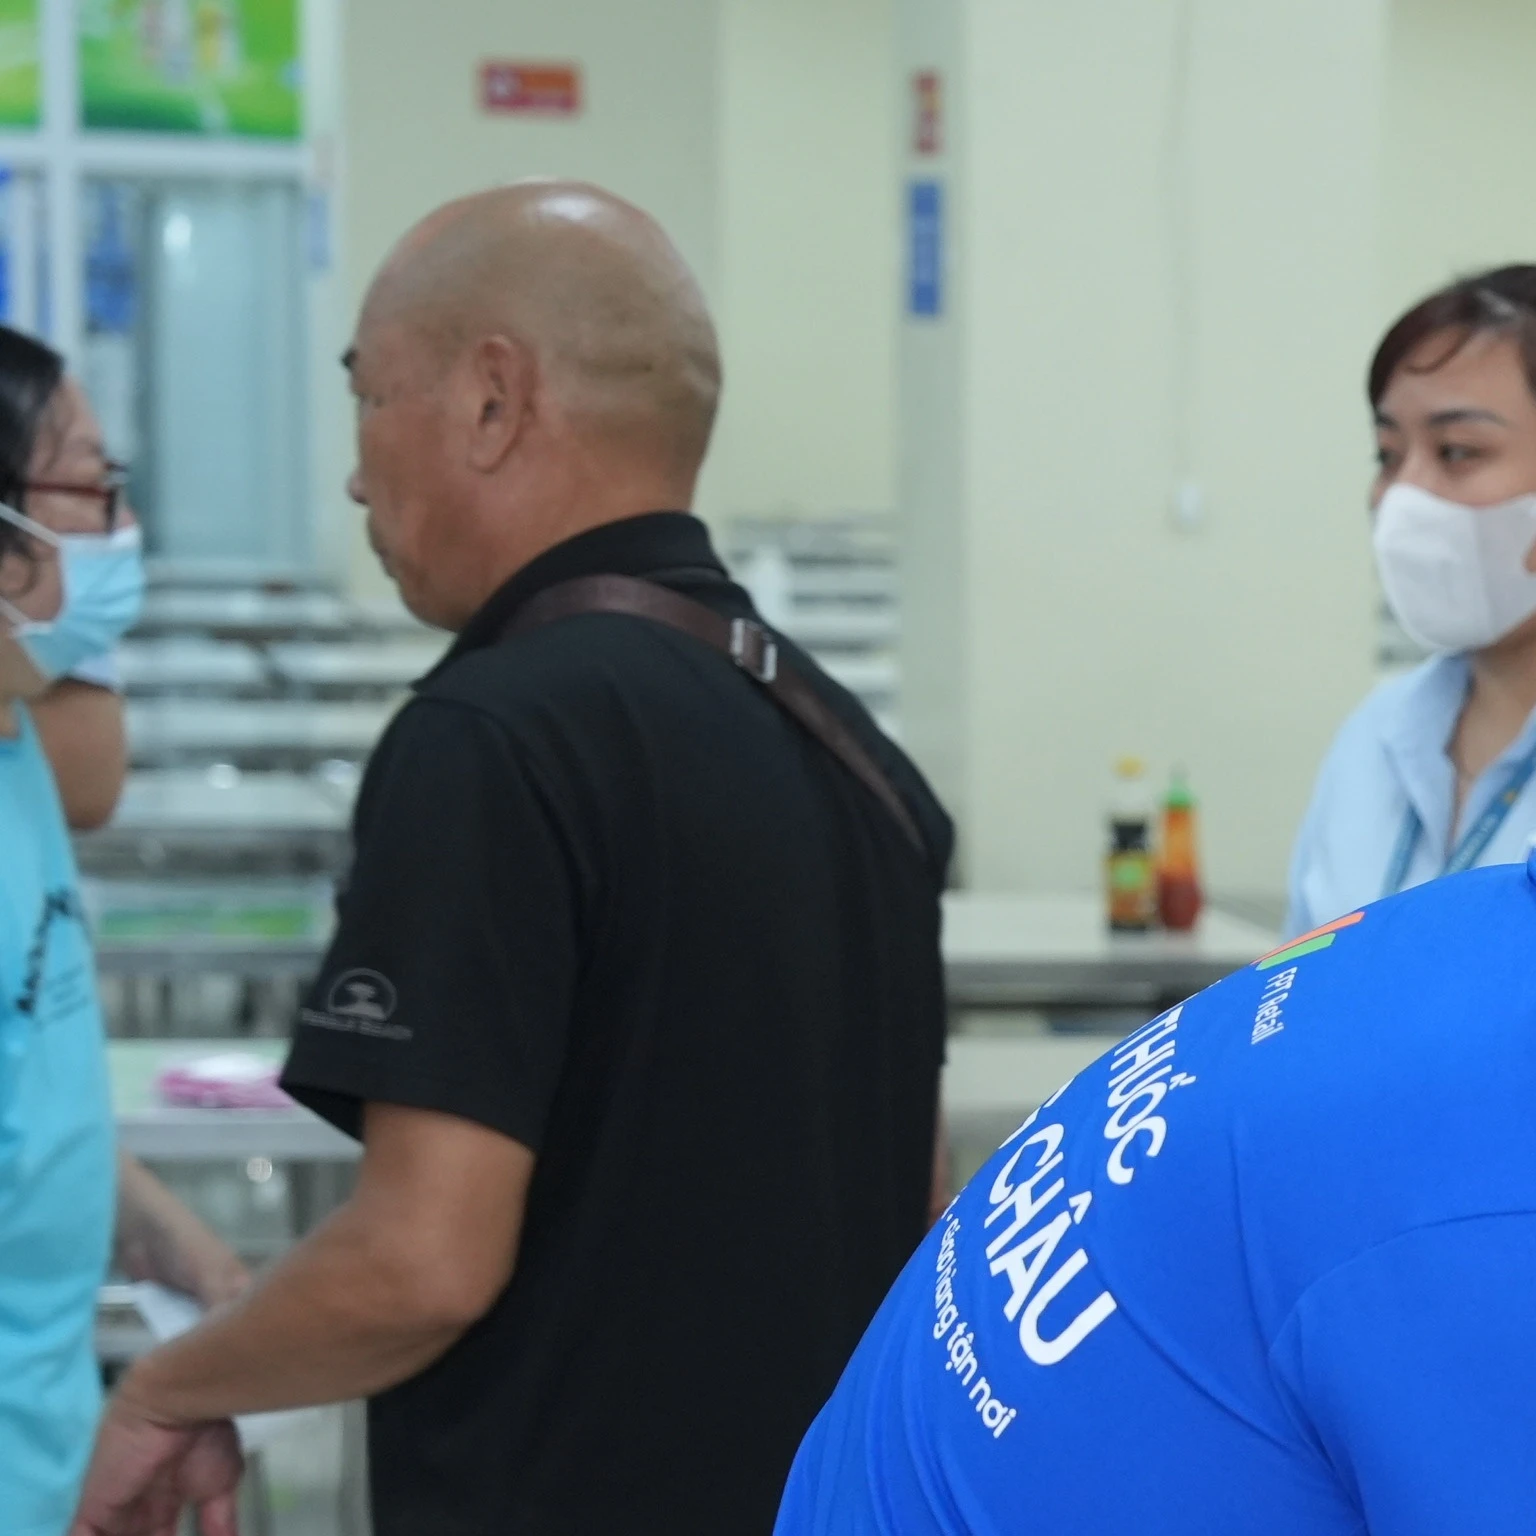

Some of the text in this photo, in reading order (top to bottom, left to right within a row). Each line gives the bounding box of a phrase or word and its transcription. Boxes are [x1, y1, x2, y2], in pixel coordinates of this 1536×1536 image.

[1251, 966, 1298, 1045] FPT Retail
[1104, 1005, 1197, 1185] THUỐC
[984, 1123, 1118, 1366] CHÂU
[945, 1321, 978, 1387] tận
[968, 1376, 1017, 1439] nơi
